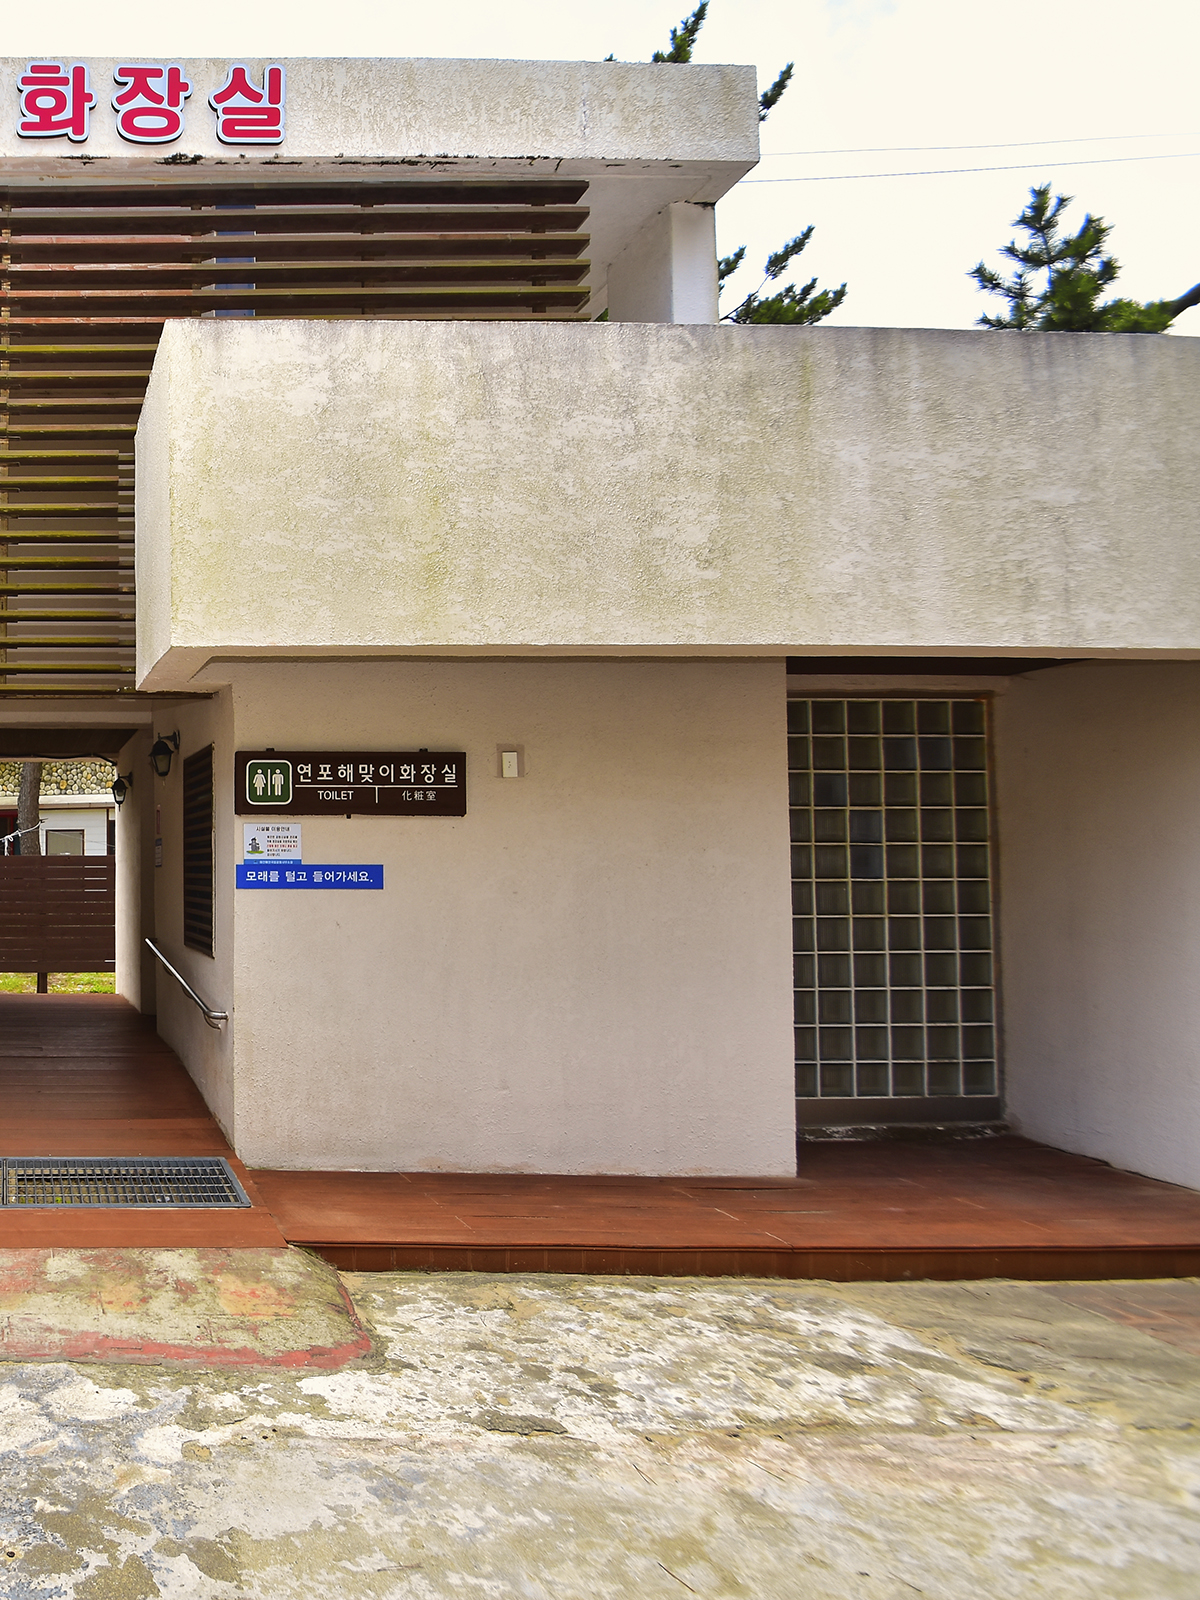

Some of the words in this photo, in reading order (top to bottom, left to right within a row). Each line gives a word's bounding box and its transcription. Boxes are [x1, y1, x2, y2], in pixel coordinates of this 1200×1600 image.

[297, 763, 458, 783] 연포해맞이화장실
[317, 790, 354, 800] TOILET
[402, 790, 437, 801] 化粧室
